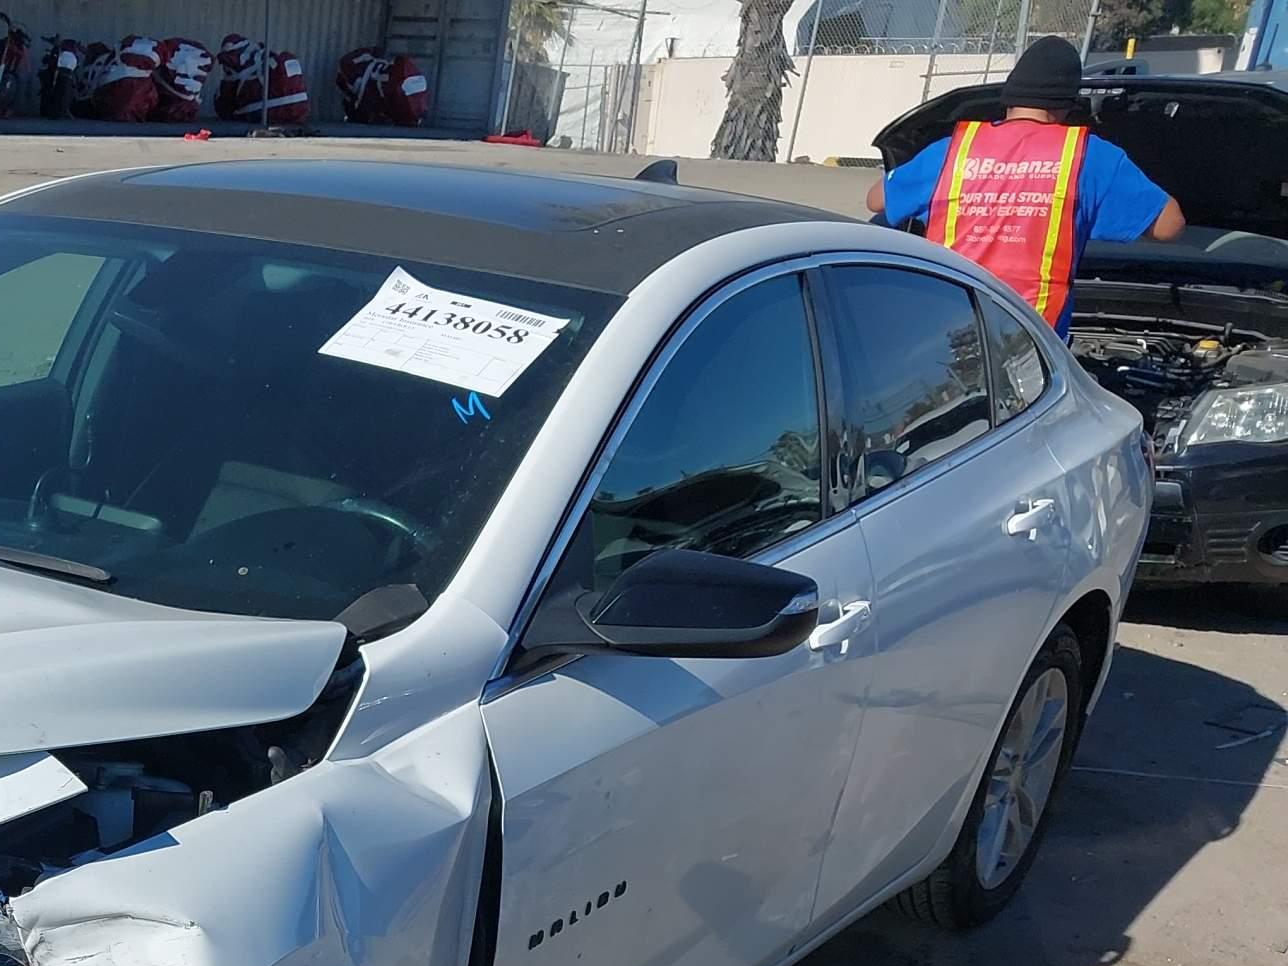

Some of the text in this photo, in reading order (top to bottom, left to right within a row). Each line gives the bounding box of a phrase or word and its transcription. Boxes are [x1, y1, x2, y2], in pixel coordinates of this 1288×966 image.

[979, 158, 1062, 174] Bonanza
[983, 192, 1009, 204] TILE
[997, 206, 1049, 217] EXPERTS
[385, 302, 530, 345] 44138058
[452, 391, 491, 425] M
[528, 880, 627, 950] MALIBU
